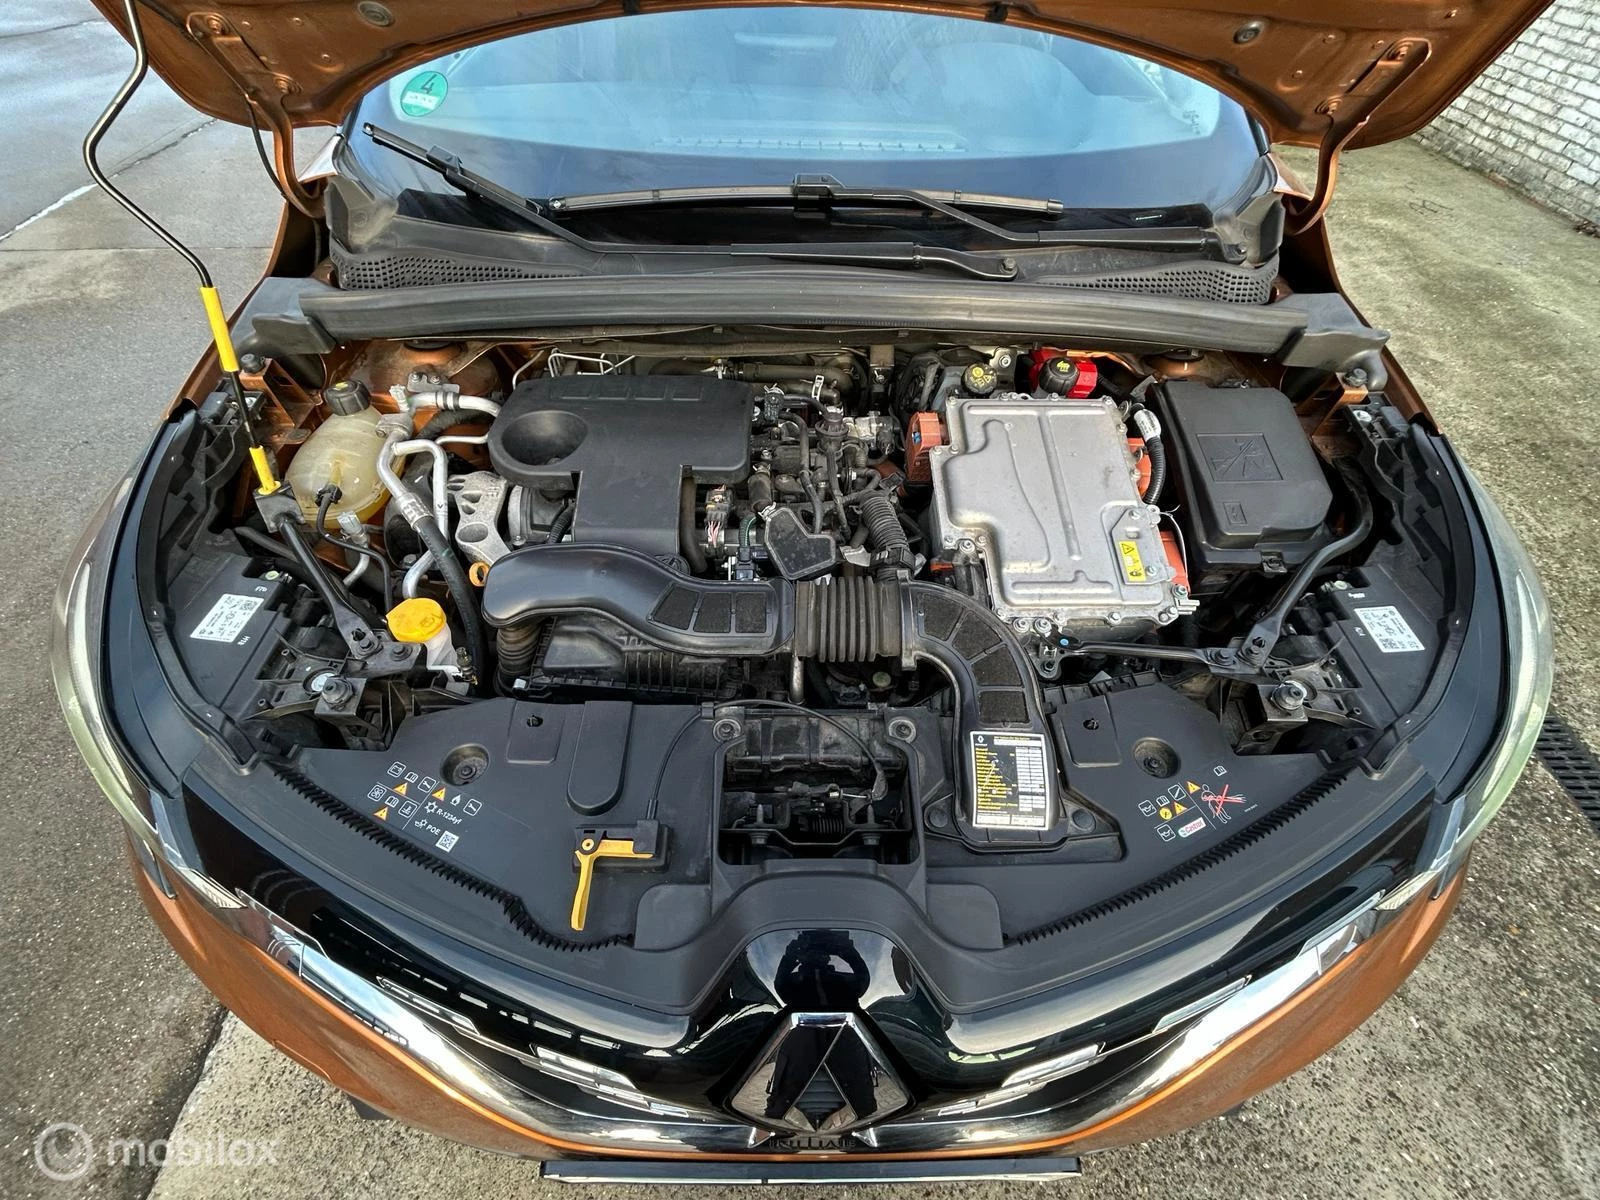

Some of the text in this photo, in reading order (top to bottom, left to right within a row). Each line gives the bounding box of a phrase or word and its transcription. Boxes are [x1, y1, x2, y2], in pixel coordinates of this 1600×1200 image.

[421, 73, 437, 95] 4
[436, 808, 463, 825] R-1234yf
[426, 824, 441, 836] POE
